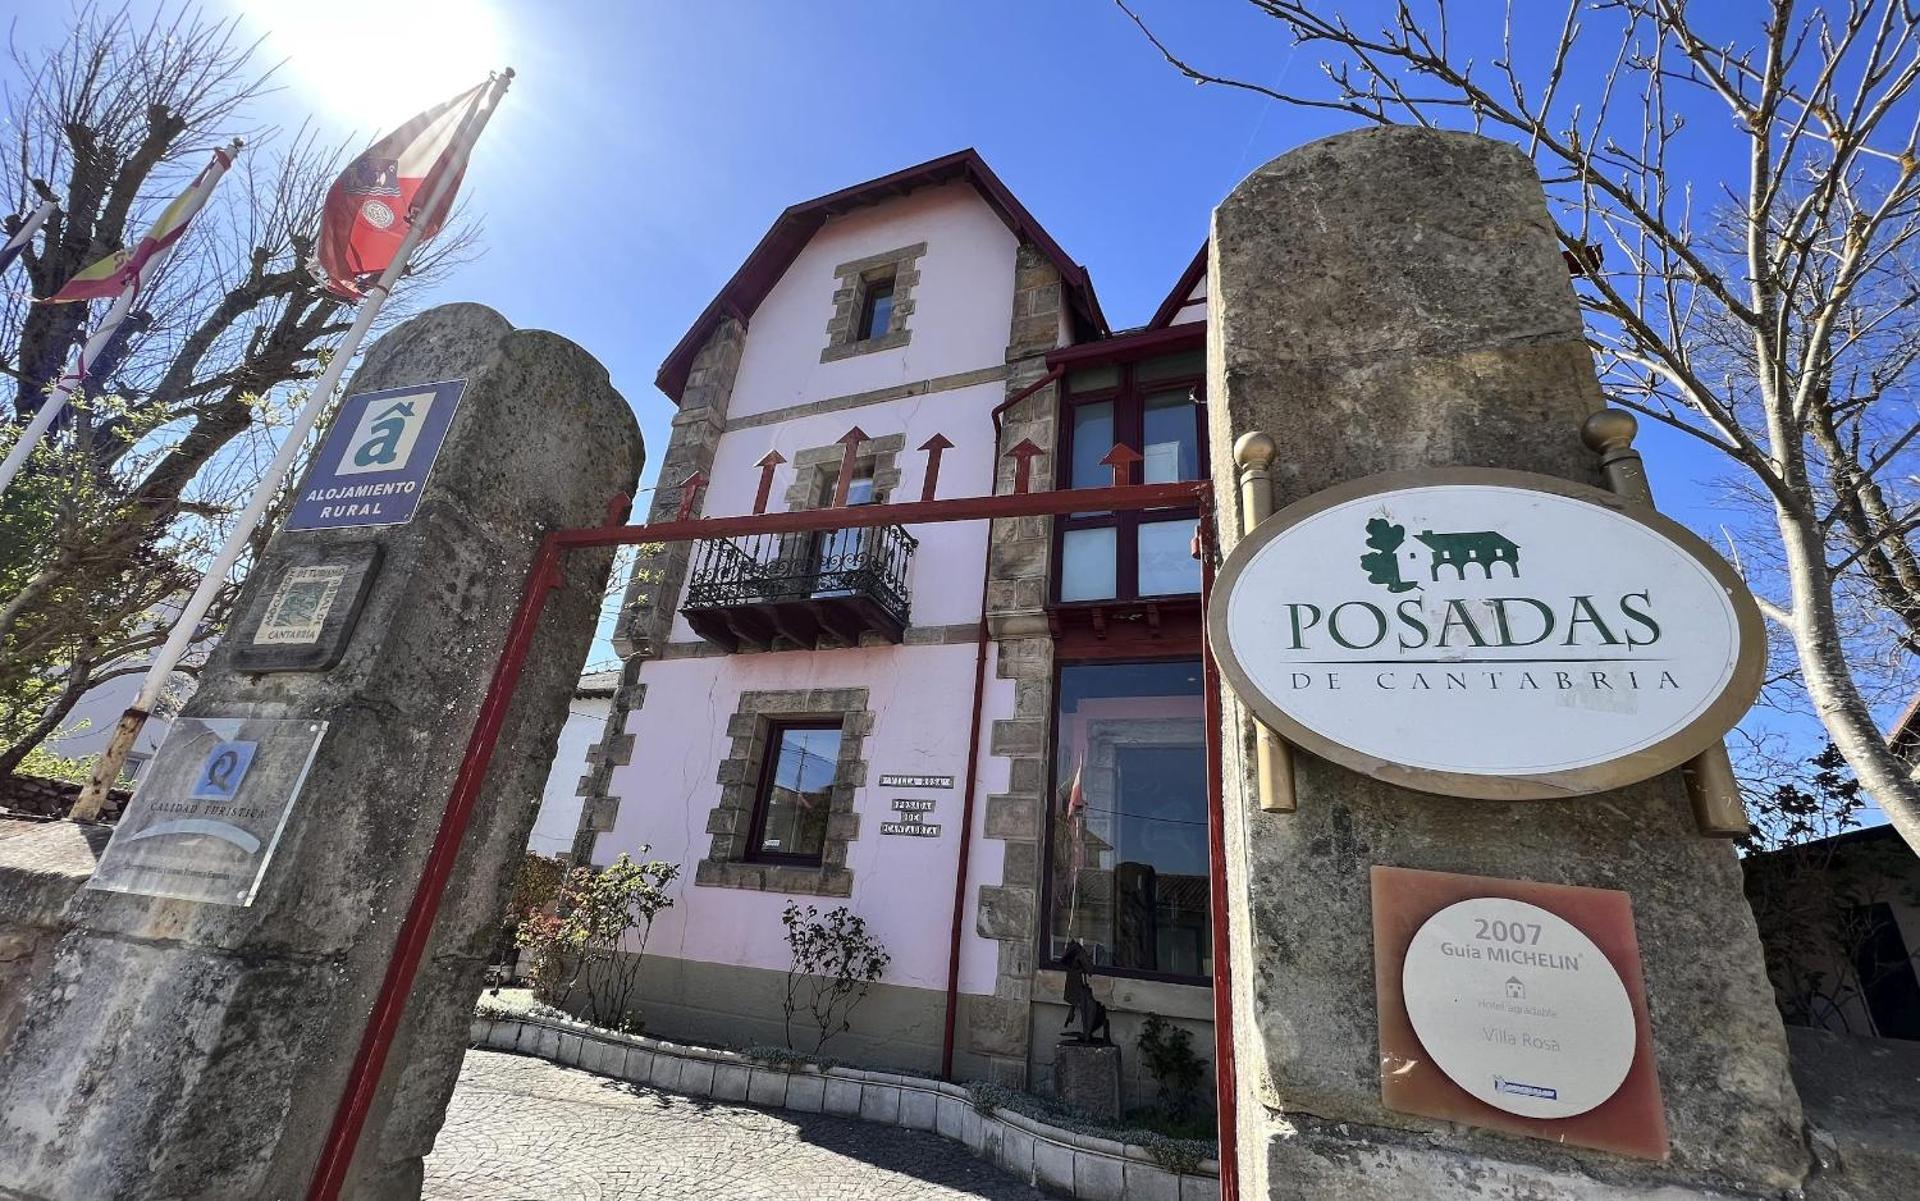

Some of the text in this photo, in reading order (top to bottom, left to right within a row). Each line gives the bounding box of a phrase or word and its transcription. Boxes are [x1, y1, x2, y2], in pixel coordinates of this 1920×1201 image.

[306, 480, 416, 502] ALOJAMIENTO
[320, 502, 382, 518] RURAL
[1282, 588, 1663, 654] POSADAS
[267, 630, 317, 640] CANTABRIA
[1291, 671, 1680, 691] DE CANTABRIA
[150, 803, 199, 815] CALIDAD
[1474, 918, 1542, 946] 2007
[1487, 947, 1580, 971] MICHELIN
[1482, 1027, 1560, 1052] Villa Rosa
